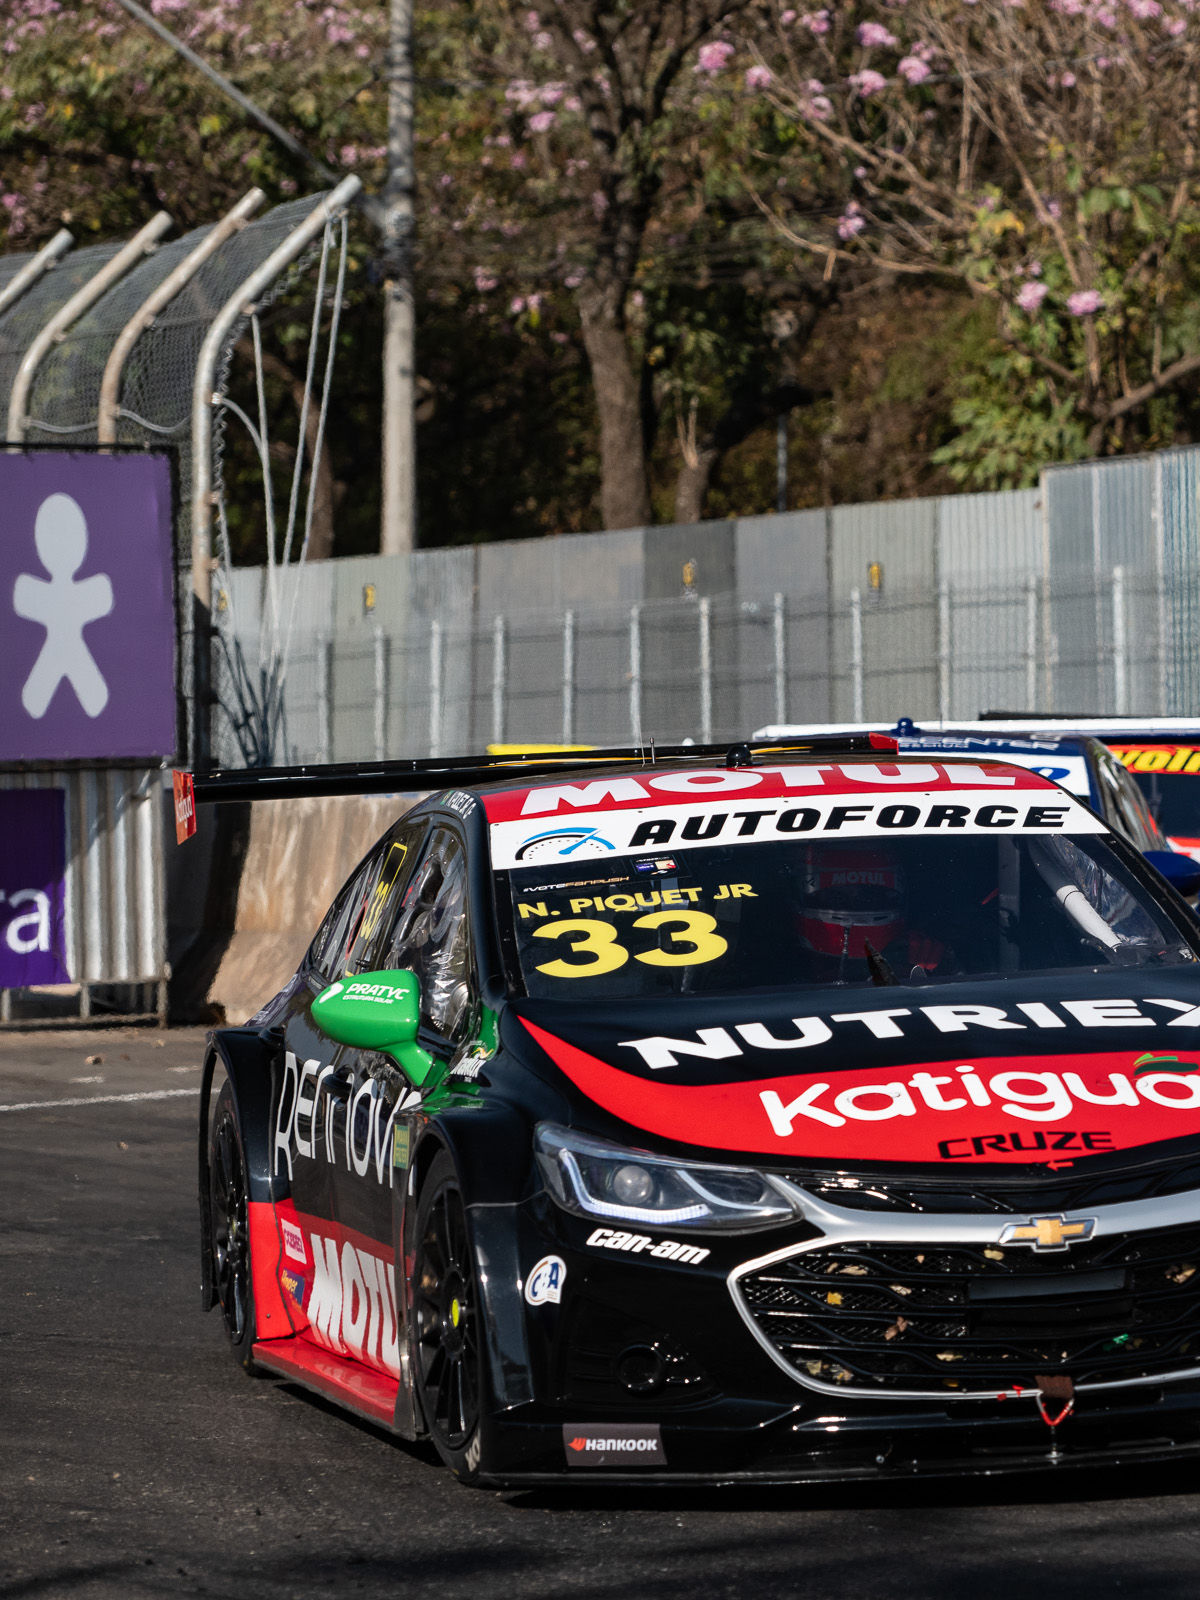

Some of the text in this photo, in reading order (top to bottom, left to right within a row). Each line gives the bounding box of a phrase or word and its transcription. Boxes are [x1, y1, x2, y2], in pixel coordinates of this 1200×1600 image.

[520, 763, 1017, 815] MOTUL
[628, 804, 1071, 848] AUTOFORCE
[831, 871, 886, 886] MOTUL
[0, 888, 50, 954] a
[518, 883, 760, 919] N. PIQUET JR
[532, 909, 729, 978] 33
[345, 983, 410, 1000] PRATYC
[937, 1130, 1117, 1159] CRUZE
[585, 1228, 711, 1265] can-am
[307, 1232, 400, 1370] MOTU
